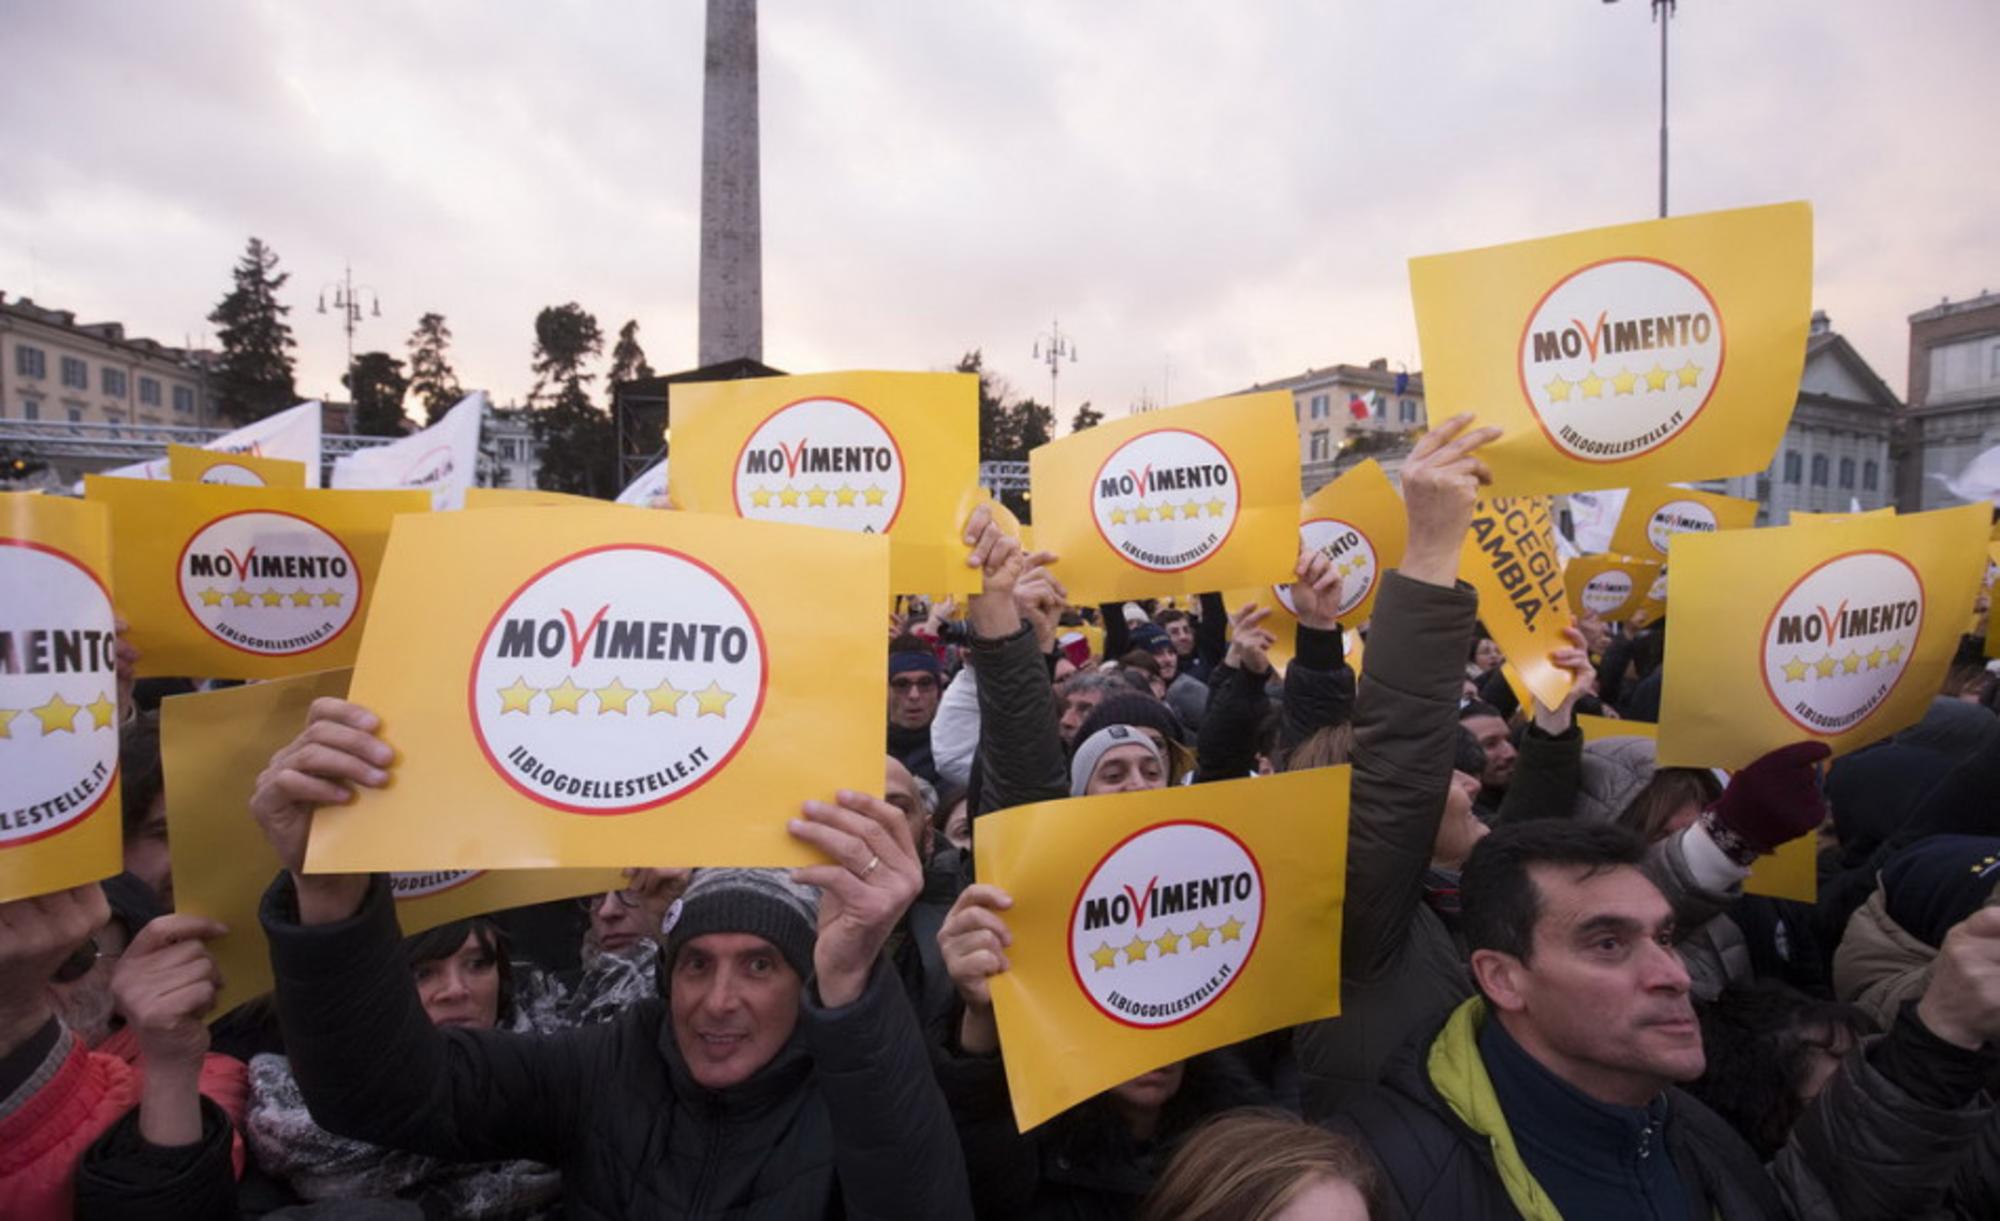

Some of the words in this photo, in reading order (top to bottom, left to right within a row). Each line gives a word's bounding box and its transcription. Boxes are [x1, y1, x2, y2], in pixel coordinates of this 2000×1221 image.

[1533, 310, 1711, 363] MOVIMENTO
[746, 438, 892, 479] MOVIMENTO
[1101, 463, 1228, 498] MOVIMENTO
[190, 546, 347, 583] MOVIMENTO
[1471, 501, 1543, 633] AMBIA.
[215, 621, 335, 650] ILBLOGDELLESTELLE.IT
[497, 603, 748, 667] MOVIMENTO
[1776, 598, 1918, 647] MOVIMENTO
[507, 745, 710, 799] ILBLOGDELLESTELLE.IT
[1083, 871, 1252, 931] MOVIMENTO
[1107, 963, 1232, 1018] ILBLOGDELLESTELLE.IT
